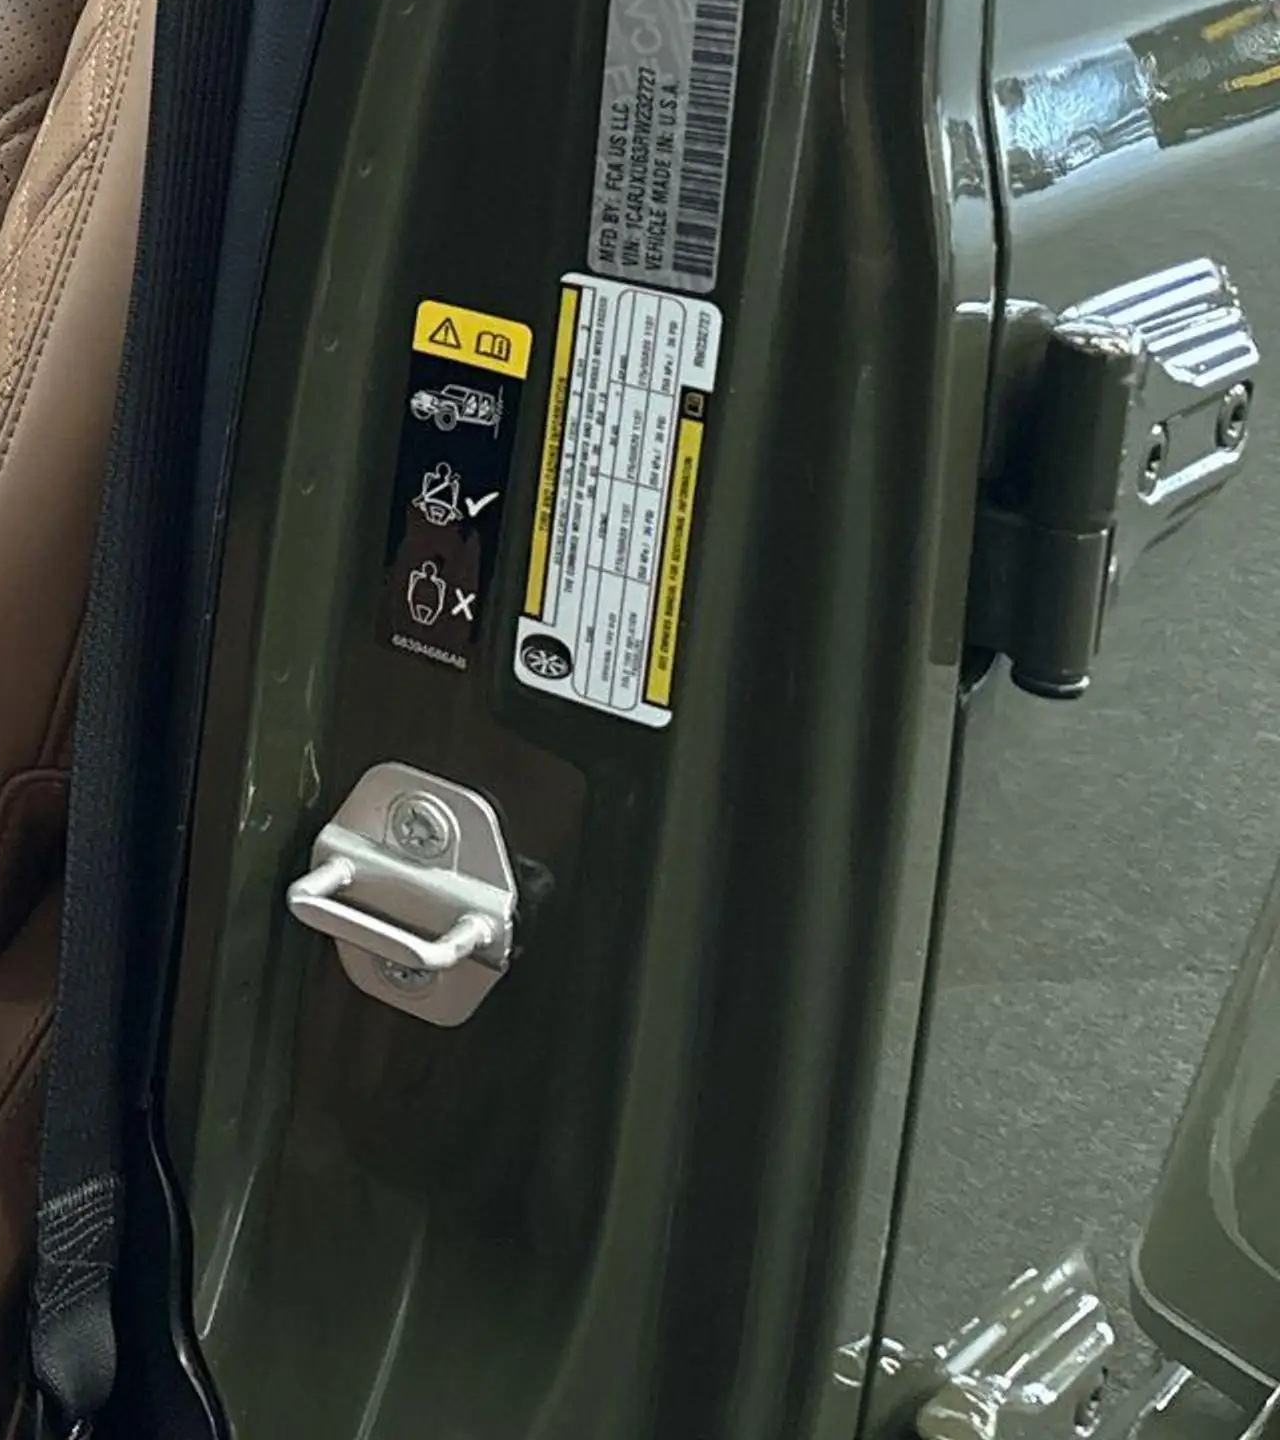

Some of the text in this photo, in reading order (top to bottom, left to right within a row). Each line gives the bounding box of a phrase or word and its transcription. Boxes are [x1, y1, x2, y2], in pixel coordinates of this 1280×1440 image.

[609, 102, 629, 131] LLC
[607, 134, 626, 157] US
[655, 130, 674, 153] IN:
[604, 162, 623, 191] FCA
[650, 158, 672, 204] MADE
[598, 227, 618, 263] MFD
[644, 208, 667, 272] VEHICLE
